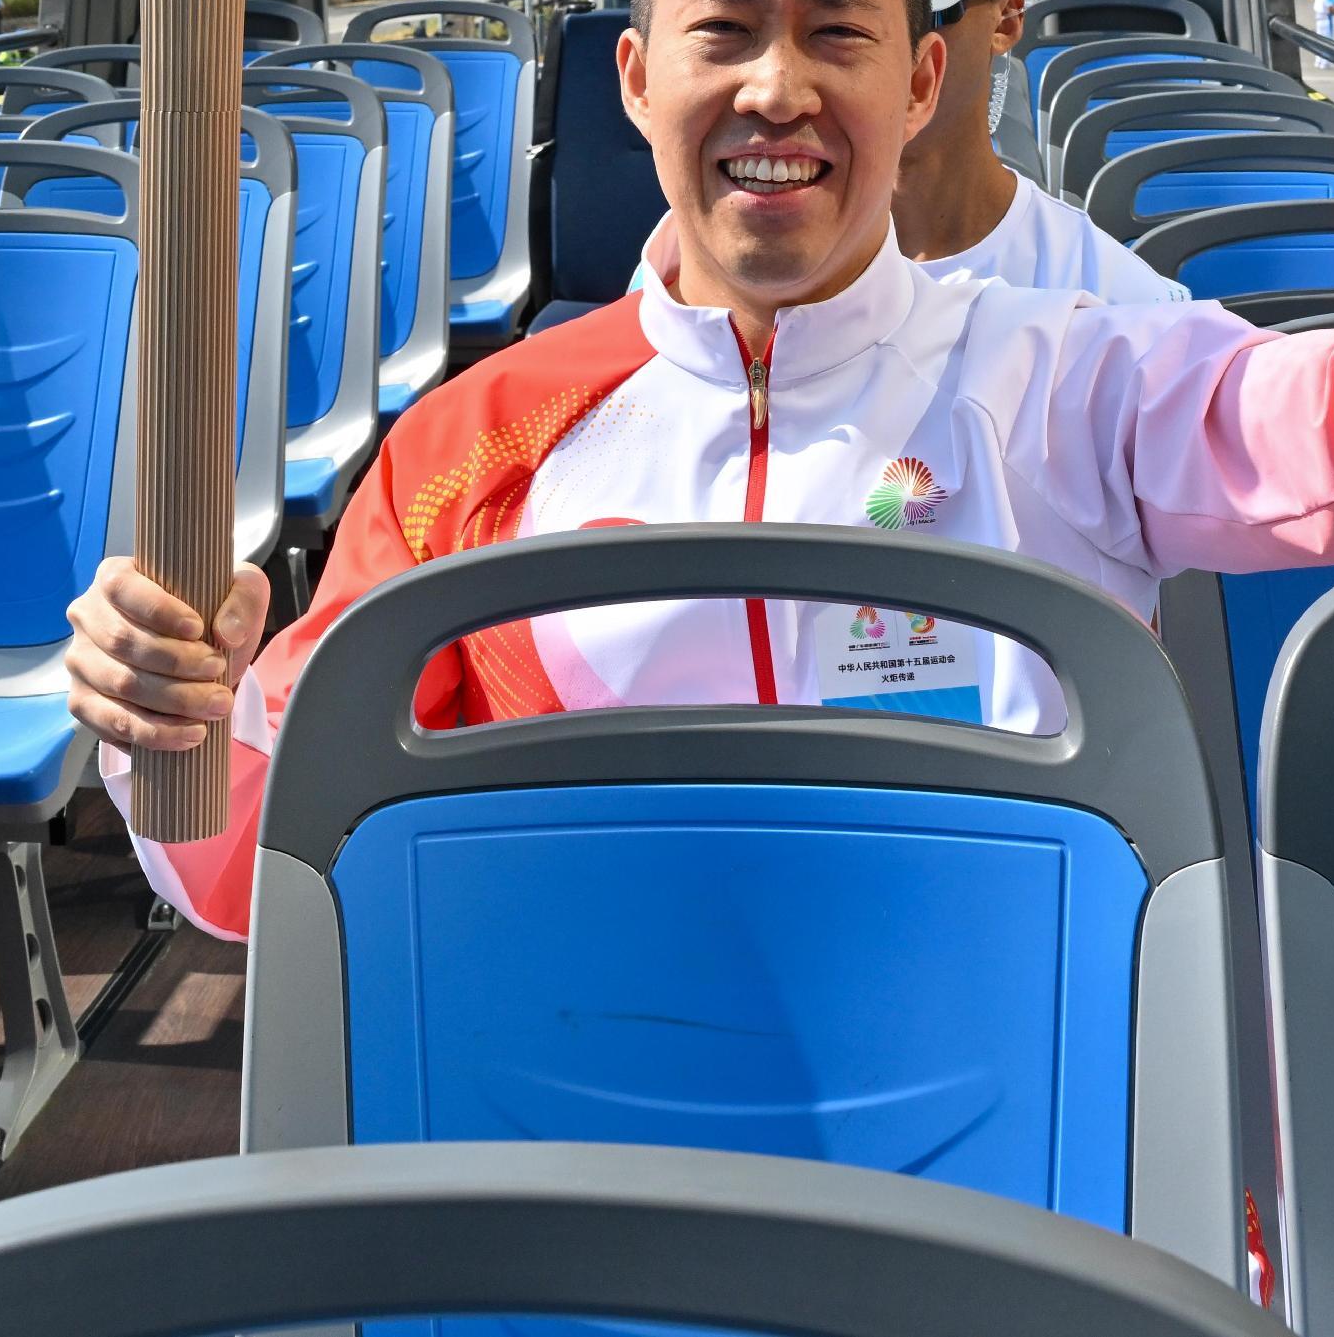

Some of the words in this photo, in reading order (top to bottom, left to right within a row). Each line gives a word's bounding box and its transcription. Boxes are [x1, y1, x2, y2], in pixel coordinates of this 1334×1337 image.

[838, 653, 956, 673] 中华人民共和国第十五届运动会
[881, 671, 915, 683] 火炬传递
